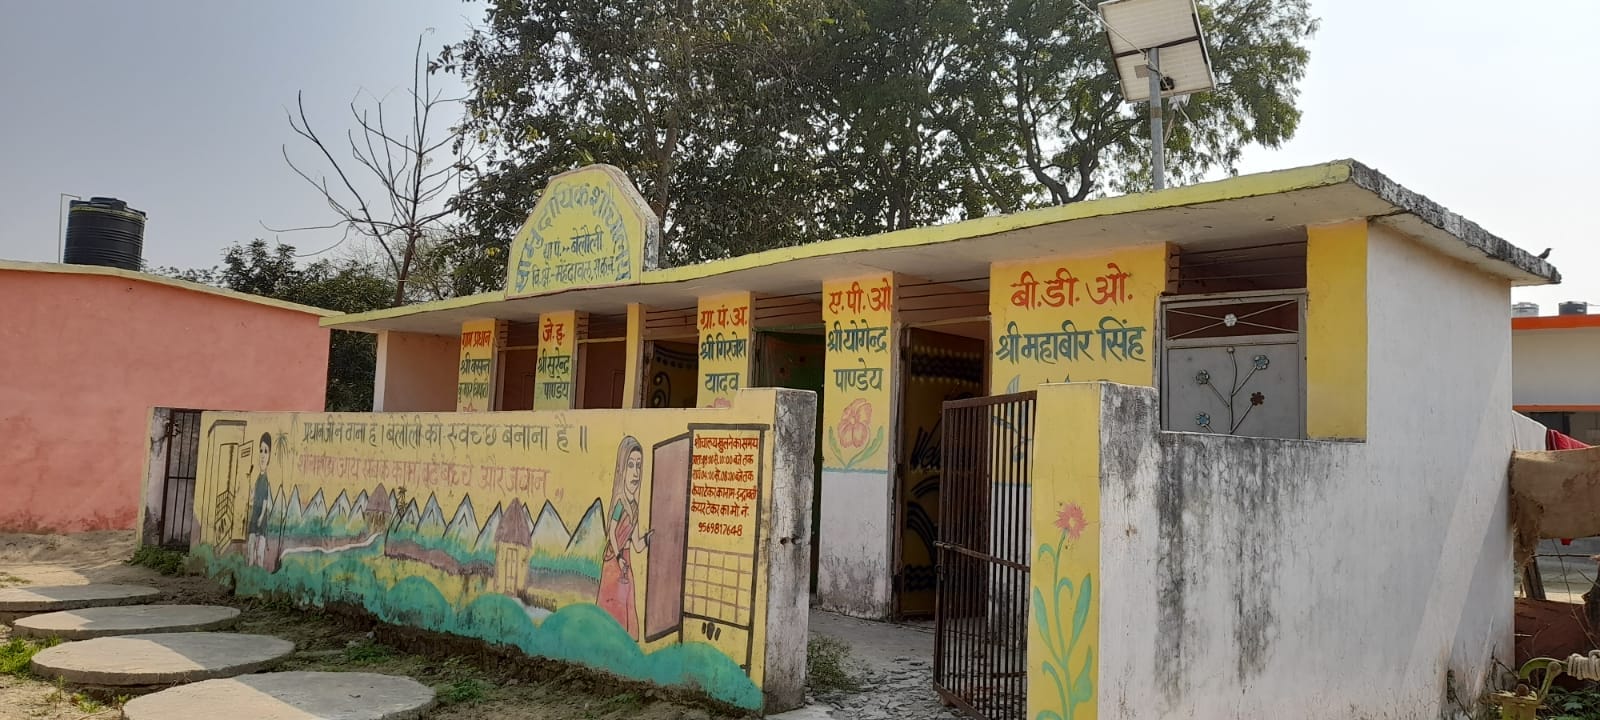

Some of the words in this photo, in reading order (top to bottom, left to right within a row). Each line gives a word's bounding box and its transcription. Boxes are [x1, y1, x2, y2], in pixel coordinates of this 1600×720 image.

[700, 333, 715, 361] श्री
[716, 331, 747, 361] गिरजेश
[827, 320, 842, 352] श्री
[843, 319, 889, 353] योगेन्द्र
[996, 321, 1021, 365] श्री
[1021, 319, 1095, 365] महाबीर
[1096, 316, 1147, 362] सिंह
[460, 352, 471, 376] श्री
[538, 348, 547, 375] श्री
[833, 358, 884, 392] पाण्डेय
[543, 376, 571, 400] पाण्डेय
[704, 372, 740, 395] यादव
[502, 423, 550, 452] बनाना
[554, 413, 574, 453] है
[698, 522, 743, 537] 9569817648
